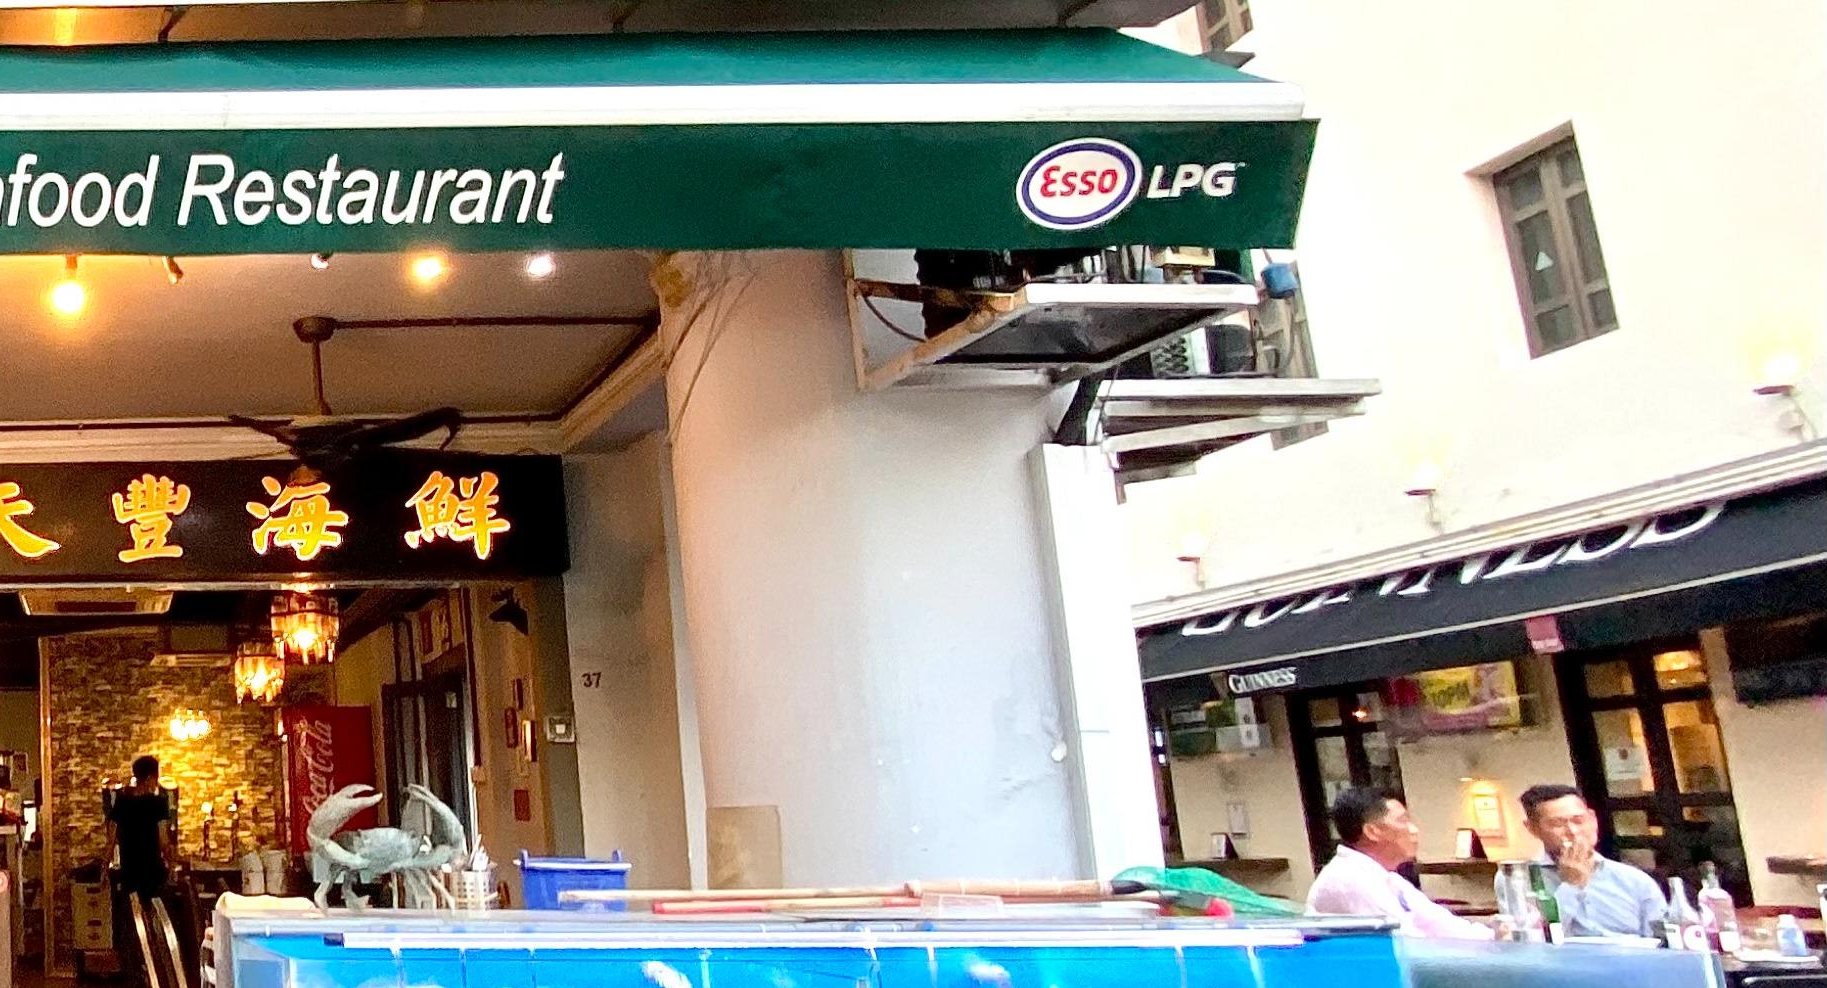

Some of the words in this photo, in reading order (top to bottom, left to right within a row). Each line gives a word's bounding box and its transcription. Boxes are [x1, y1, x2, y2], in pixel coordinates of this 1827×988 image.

[176, 151, 566, 226] Restaurant
[1146, 161, 1238, 199] LPG
[581, 671, 602, 689] 37
[1228, 665, 1298, 695] GUINNESS
